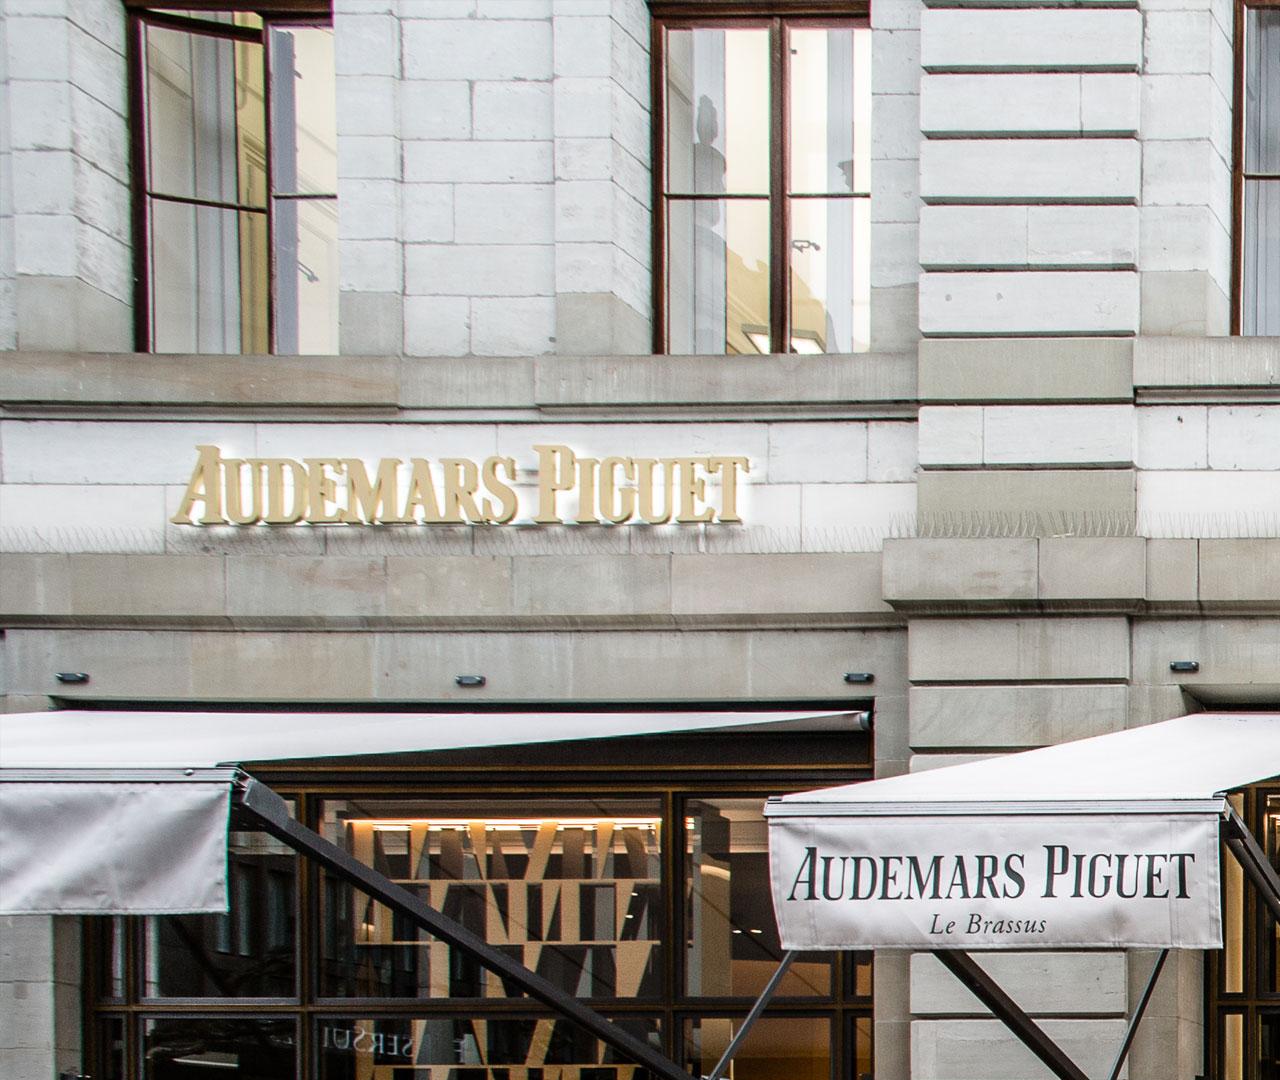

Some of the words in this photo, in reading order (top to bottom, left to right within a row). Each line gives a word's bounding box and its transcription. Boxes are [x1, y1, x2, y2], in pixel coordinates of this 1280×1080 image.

[170, 444, 518, 525] AUDEMARS
[532, 444, 750, 525] PIGUET
[786, 846, 1026, 901] AUDEMARS
[1041, 844, 1196, 900] PIGUET
[929, 913, 955, 935] Le
[965, 913, 1048, 935] Brassus
